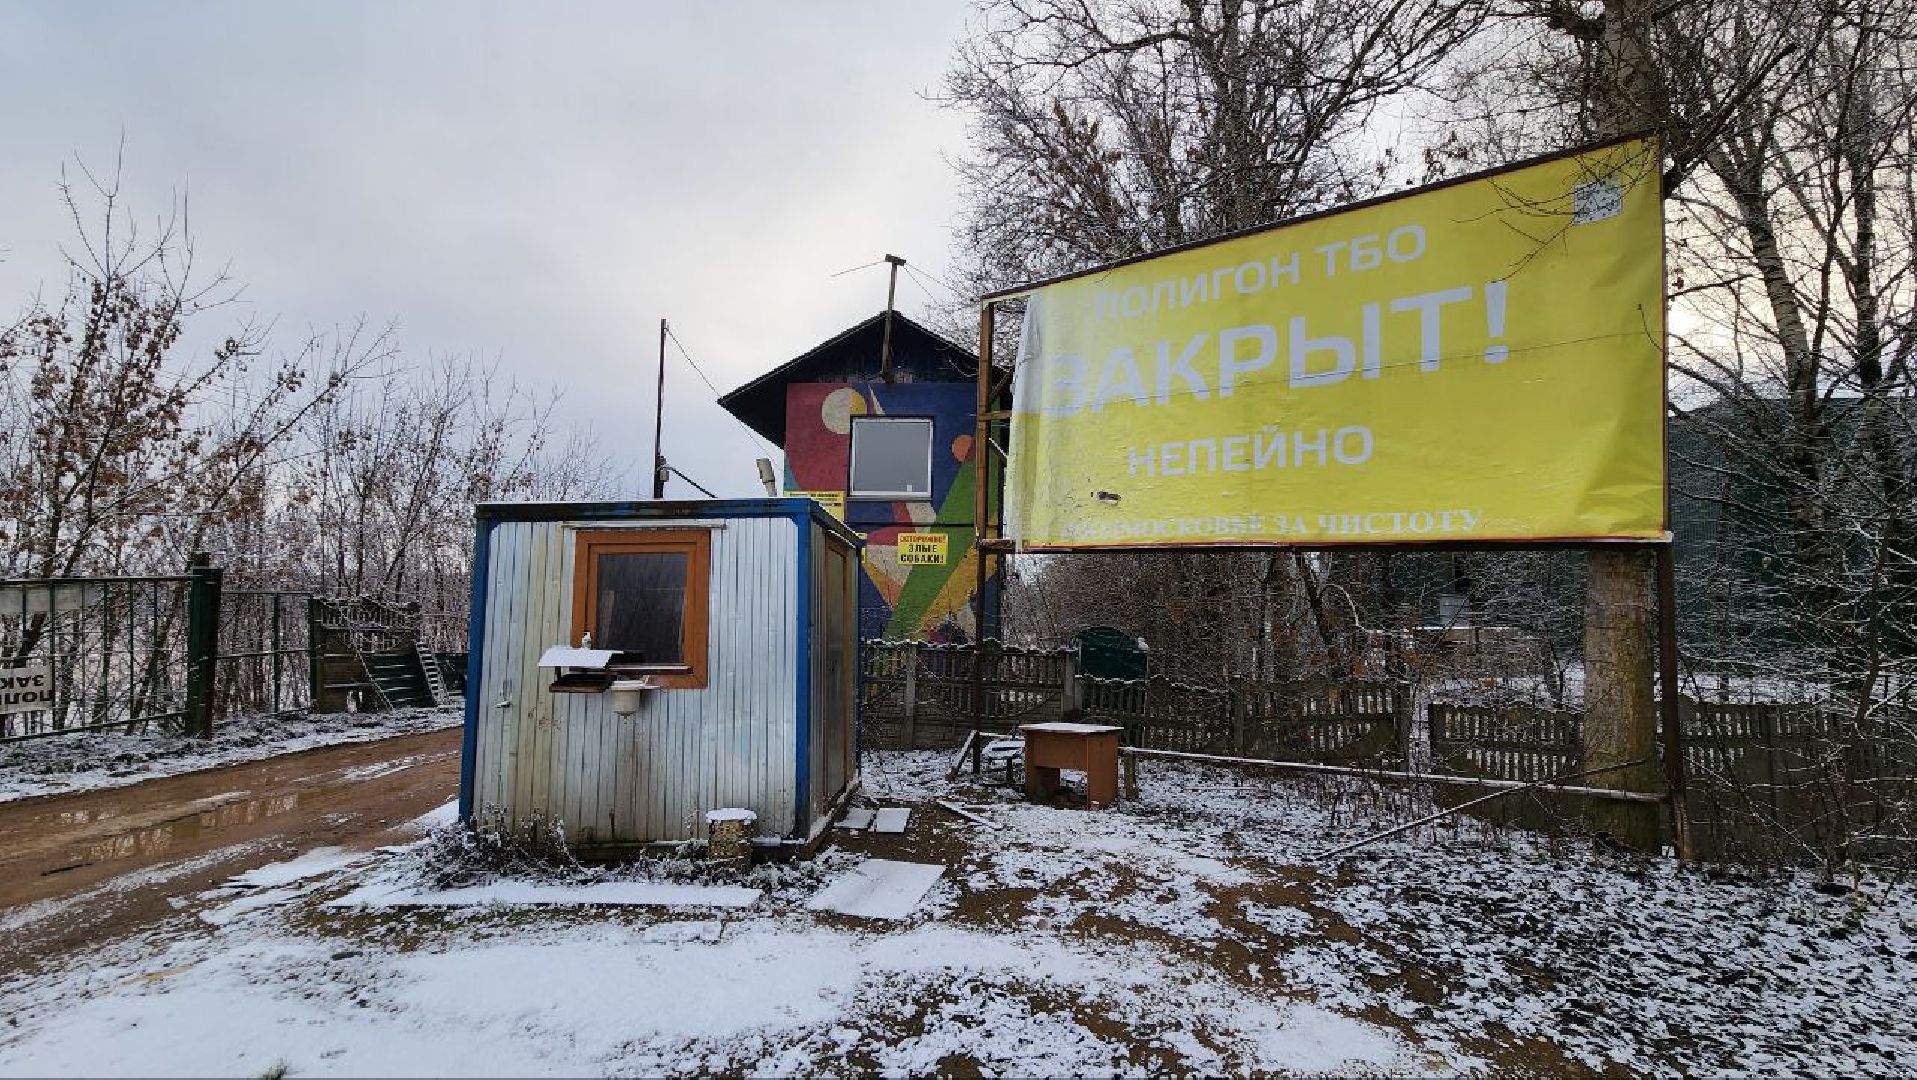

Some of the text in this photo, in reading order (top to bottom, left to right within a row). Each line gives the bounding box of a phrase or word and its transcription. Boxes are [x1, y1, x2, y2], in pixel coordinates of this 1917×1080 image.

[1095, 224, 1427, 324] ПОЛИГОН ТБО
[1043, 281, 1510, 418] ЗАКРЫТ!
[1128, 425, 1374, 479] НЕПЕЙНО
[1274, 515, 1309, 535] ЗА
[1318, 509, 1484, 537] ЧИСТОТУ
[900, 554, 944, 564] СОБАКИ!
[909, 544, 937, 552] ЗЛЫЕ
[0, 690, 53, 705] ПОЛ
